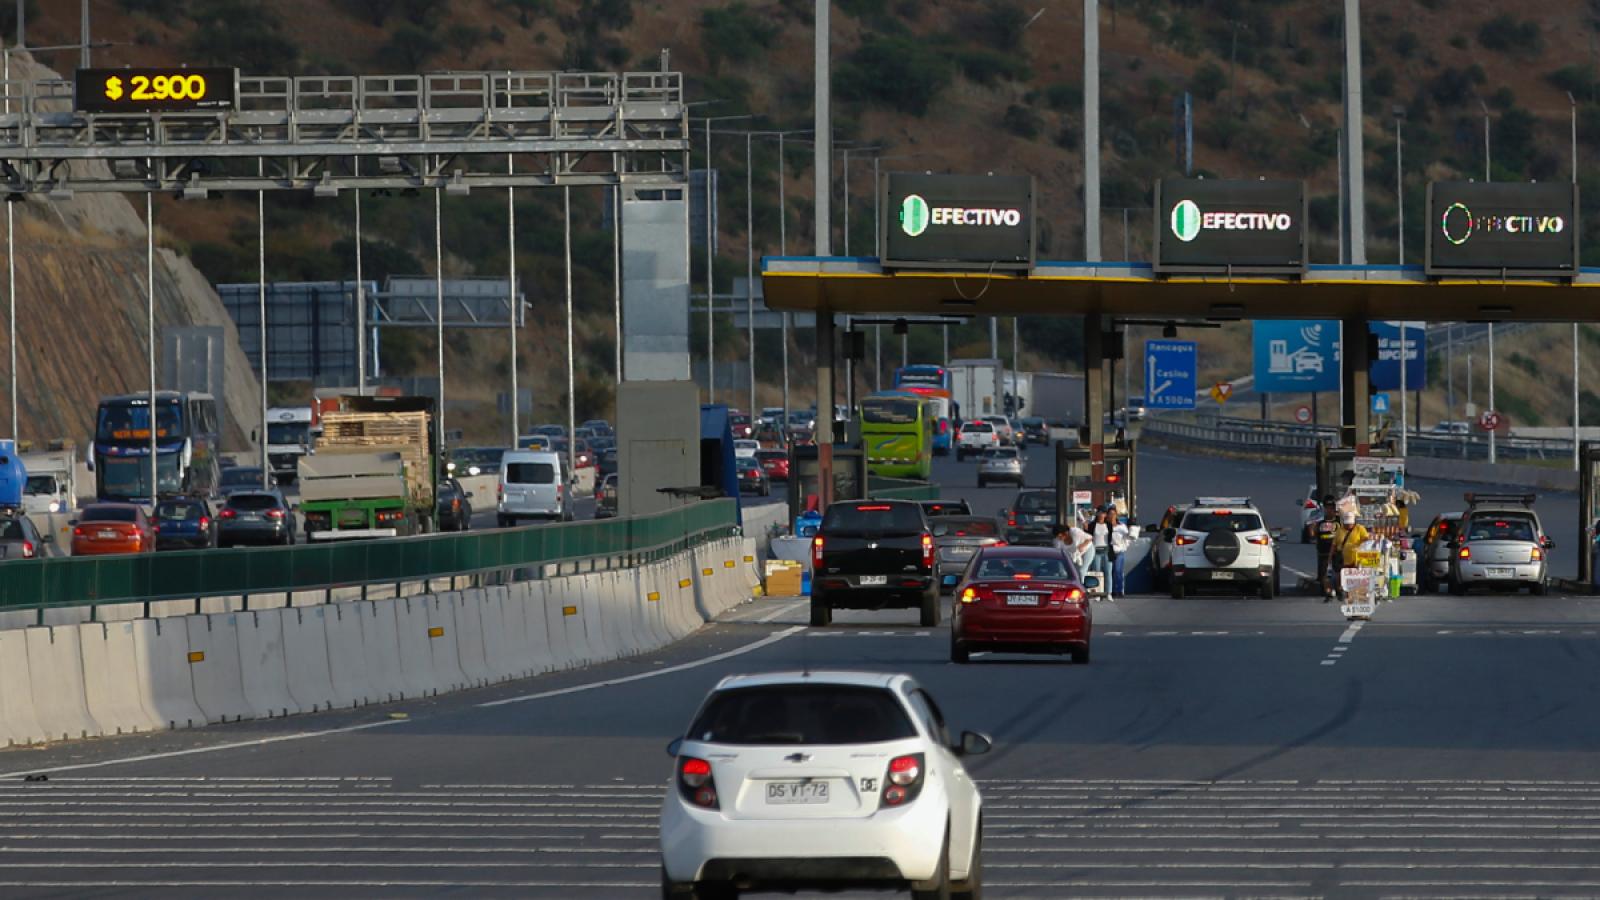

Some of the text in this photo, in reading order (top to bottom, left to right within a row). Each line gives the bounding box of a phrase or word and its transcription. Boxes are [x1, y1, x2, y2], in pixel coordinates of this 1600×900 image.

[105, 75, 206, 100] $ 2.900
[931, 207, 1020, 226] EFECTIVO
[1203, 212, 1291, 230] EFECTIVO
[1476, 215, 1564, 233] CTIVO
[1149, 343, 1193, 353] Rancagua
[1156, 369, 1189, 378] Casino
